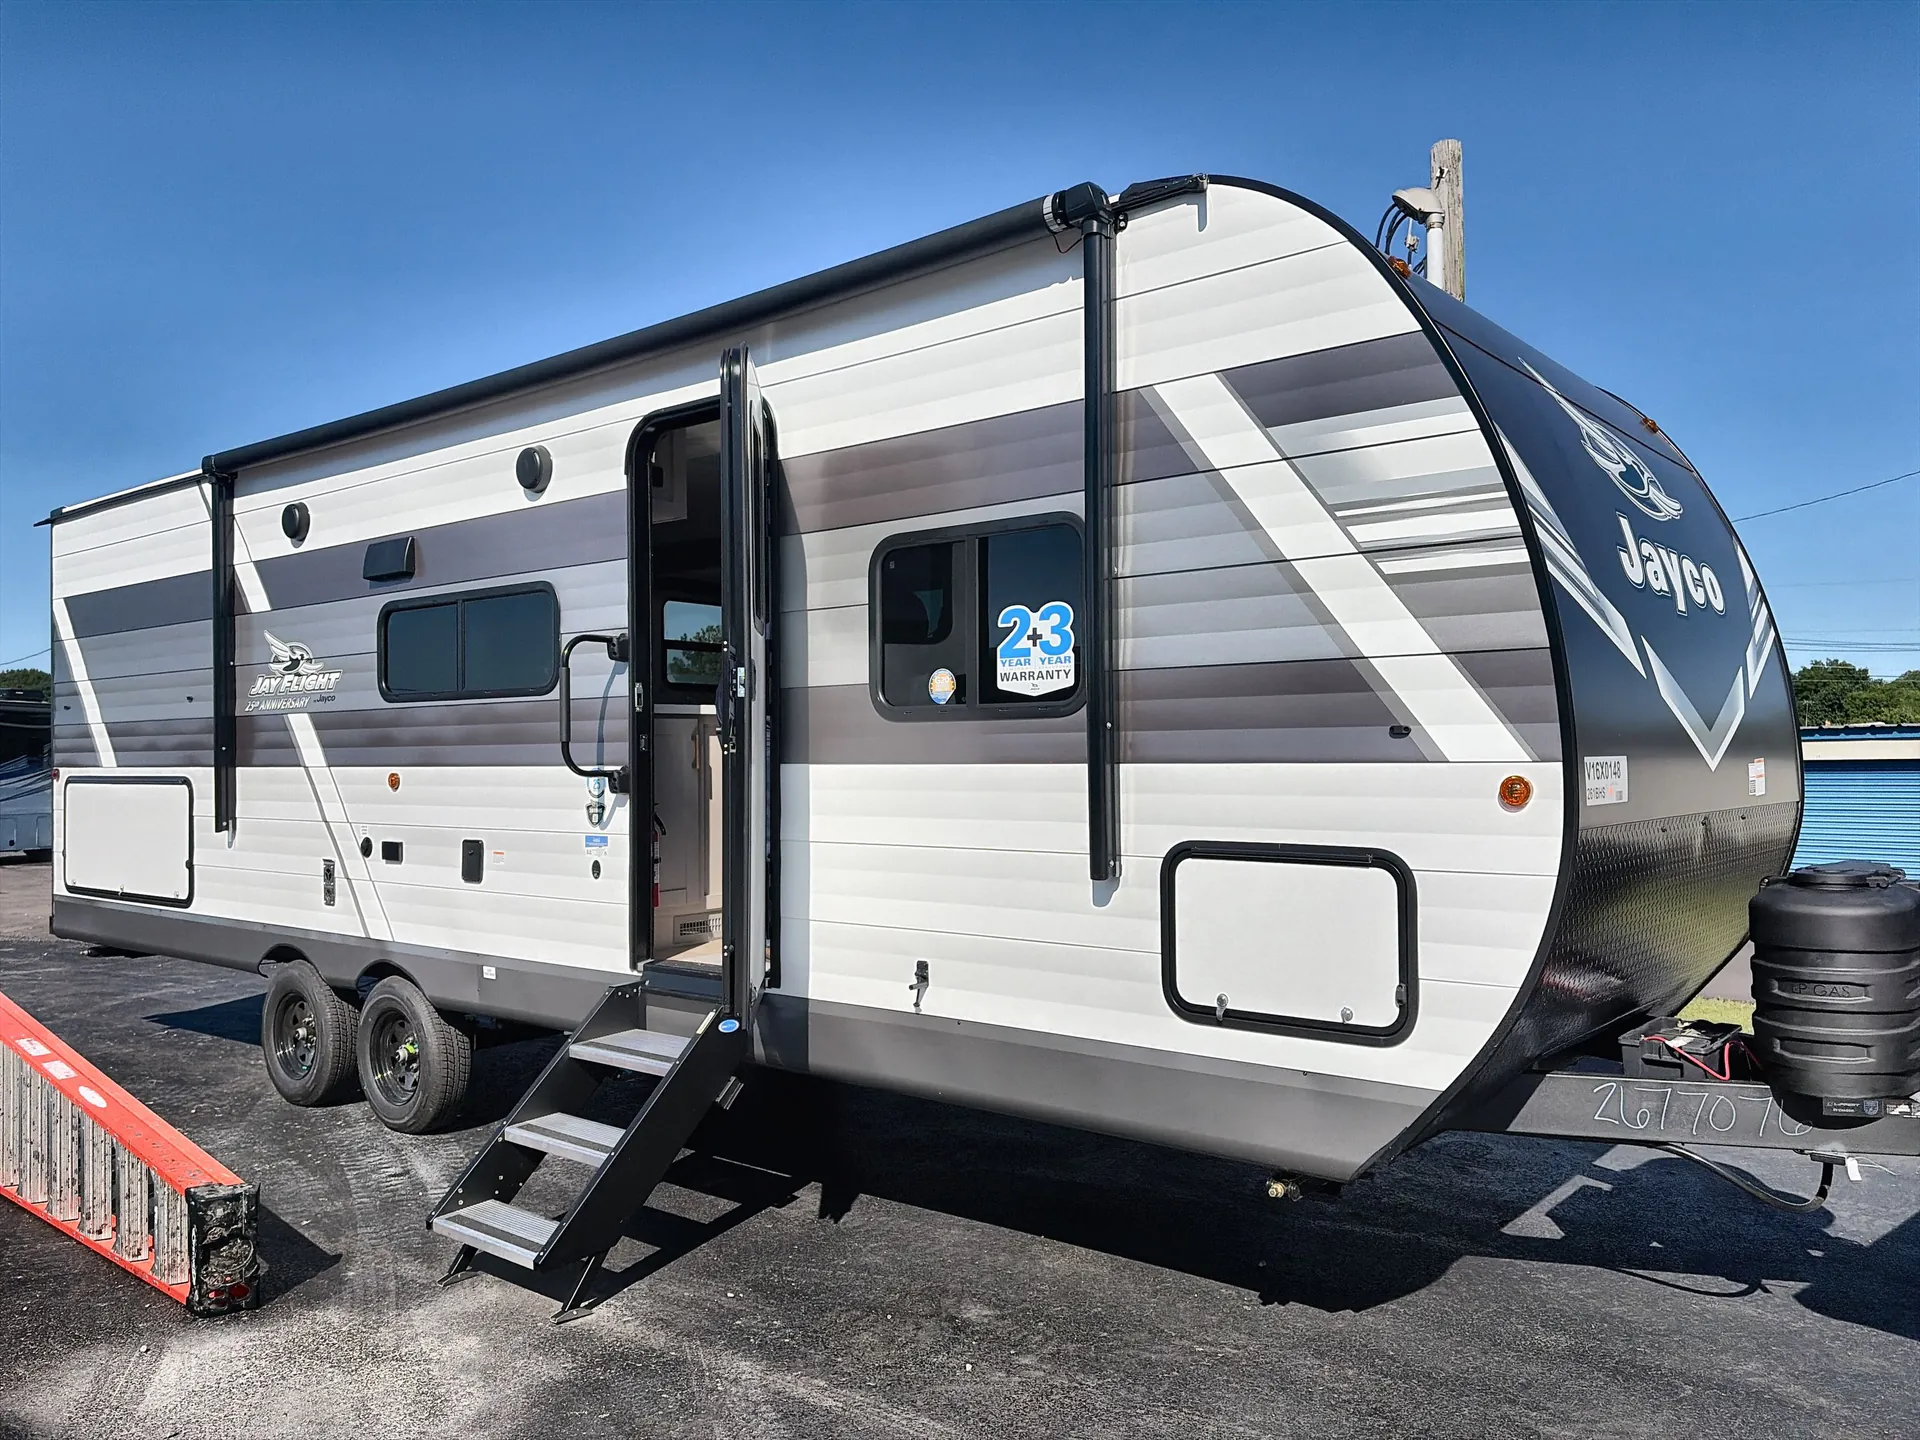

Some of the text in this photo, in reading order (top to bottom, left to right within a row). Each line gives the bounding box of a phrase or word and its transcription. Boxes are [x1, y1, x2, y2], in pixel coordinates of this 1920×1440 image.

[1615, 511, 1726, 616] Jayco
[1000, 655, 1072, 667] YEAR YEAR
[248, 670, 342, 697] JAY FLIGHT
[1000, 669, 1072, 682] WARRANTY
[258, 696, 312, 711] ANNIVERSARY
[1585, 760, 1622, 781] V16X0148
[1813, 984, 1851, 998] GAS
[1593, 1082, 1813, 1138] 2677076
